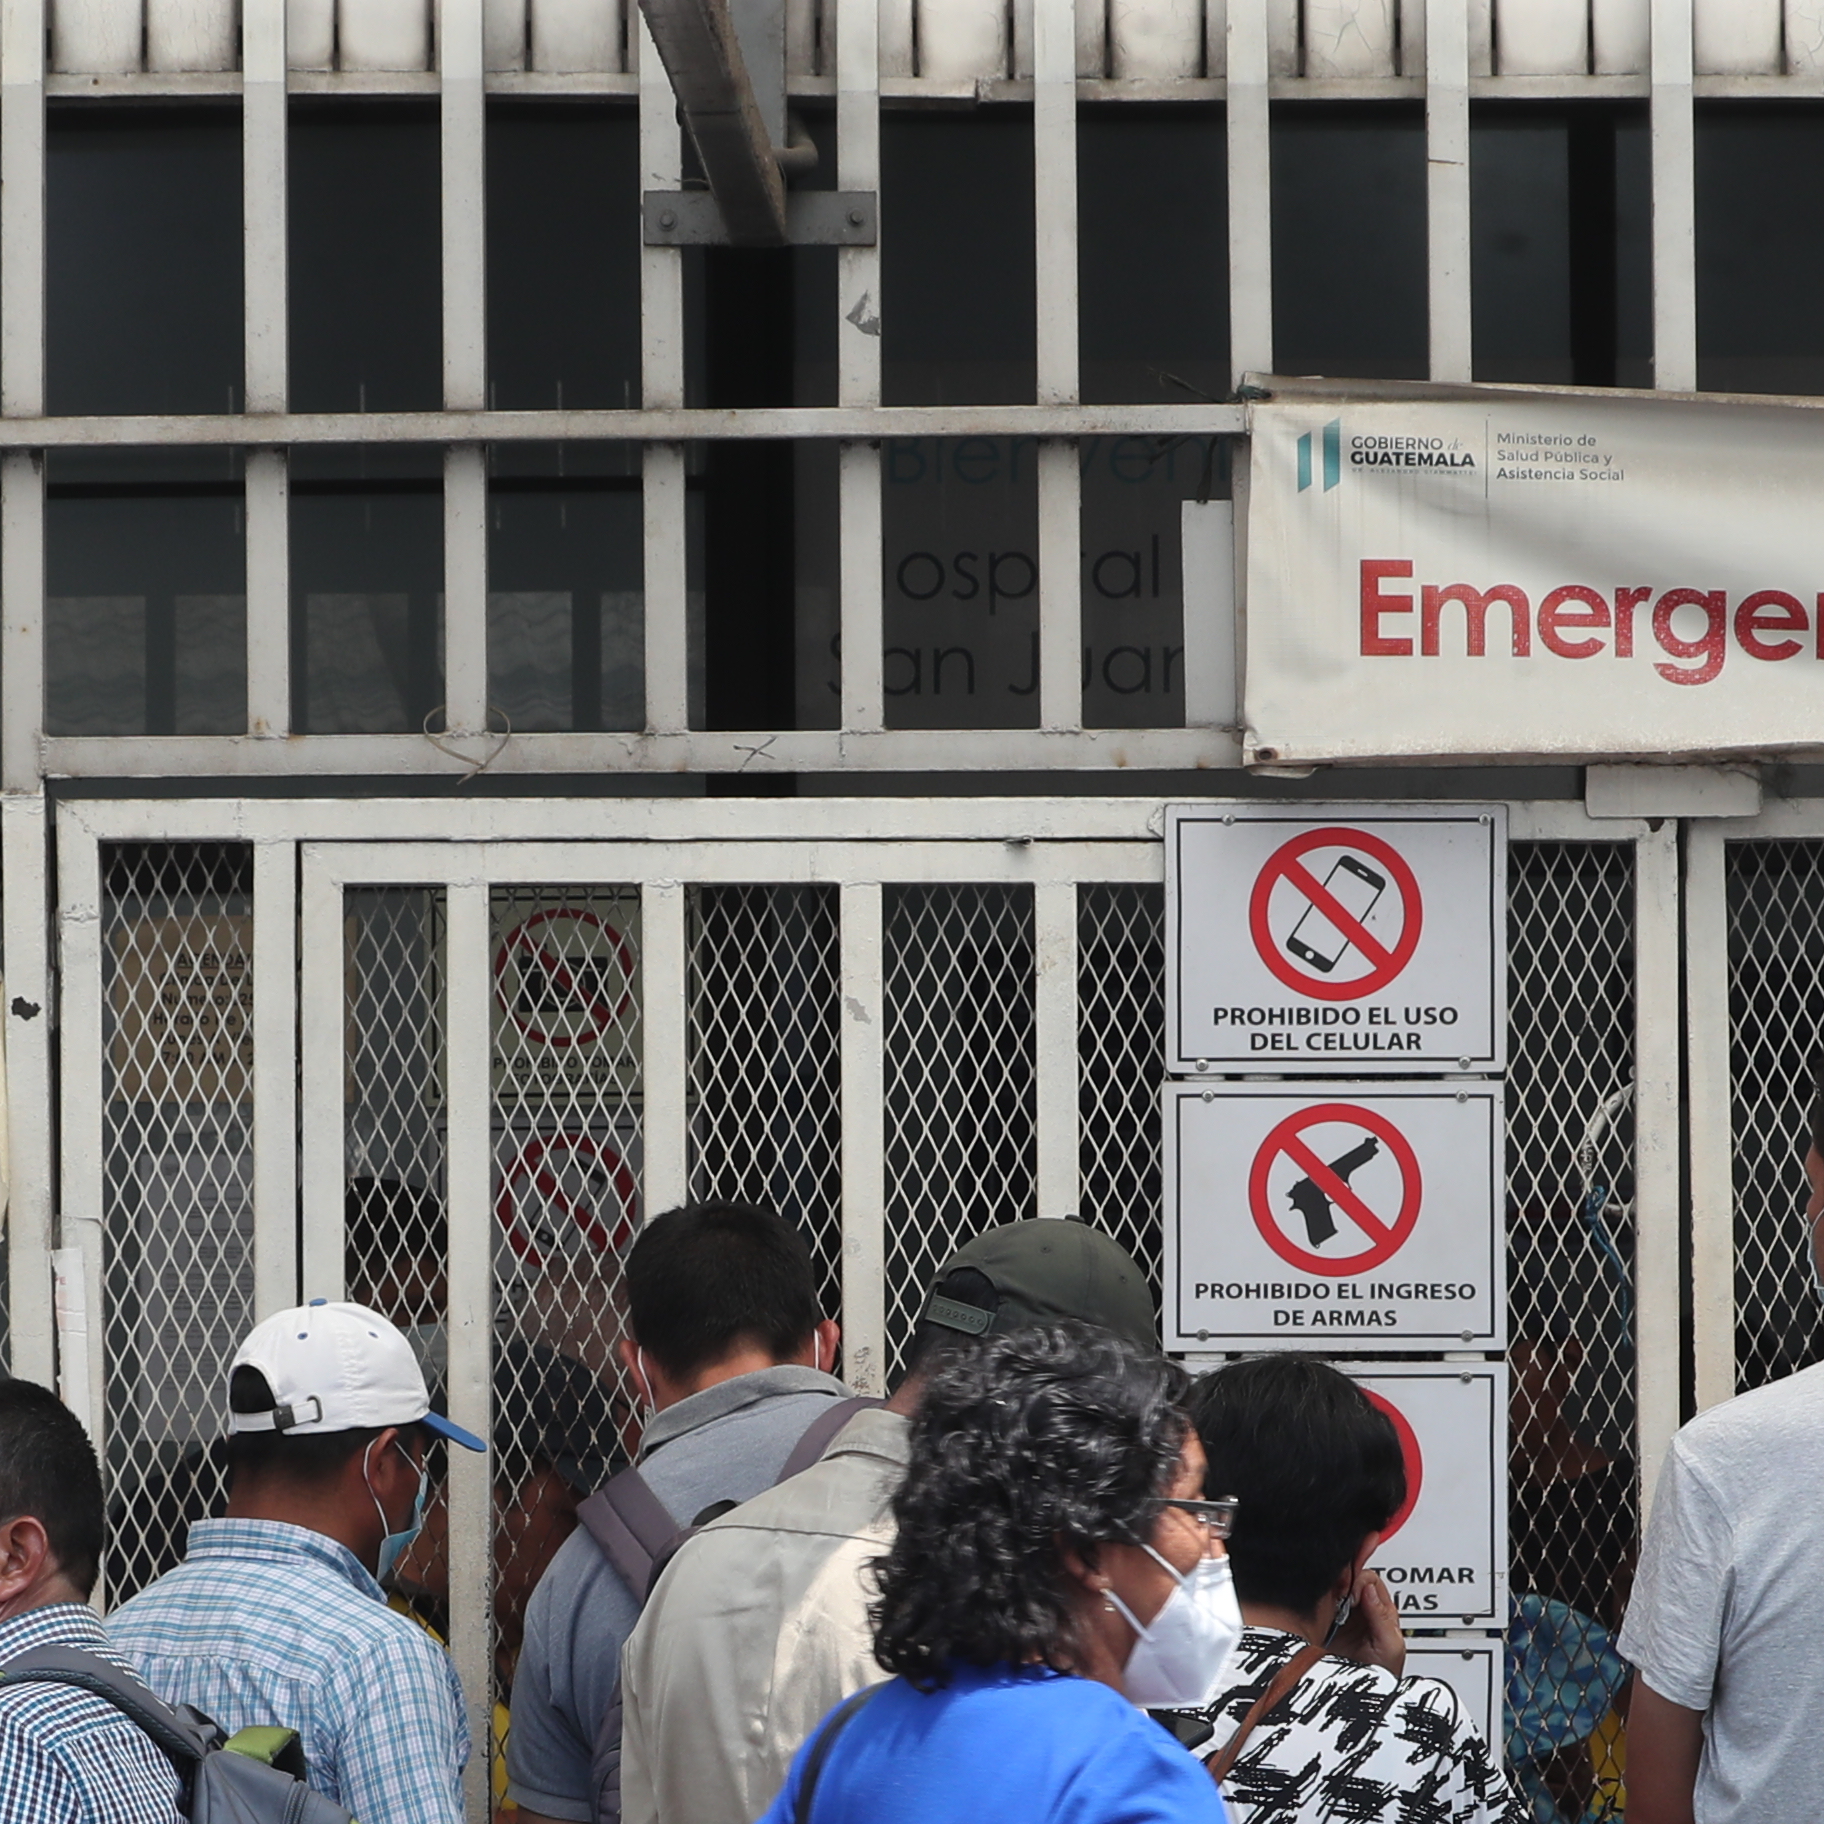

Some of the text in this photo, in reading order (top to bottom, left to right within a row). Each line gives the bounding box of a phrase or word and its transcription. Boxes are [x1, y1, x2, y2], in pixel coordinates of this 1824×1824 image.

[1351, 436, 1443, 450] GOBIERNO
[1497, 433, 1597, 447] Ministerio de
[1350, 451, 1475, 467] GUATEMALA
[1497, 450, 1613, 466] Salud Pública y
[1497, 467, 1624, 481] Asistencia Social
[1214, 1007, 1459, 1026] PROHIBIDO EL USO
[1250, 1032, 1422, 1050] DEL CELULAR
[1194, 1283, 1476, 1300] PROHIBIDO EL INGRESO
[1274, 1310, 1397, 1326] DE ARMAS
[1370, 1567, 1475, 1584] TOMAR
